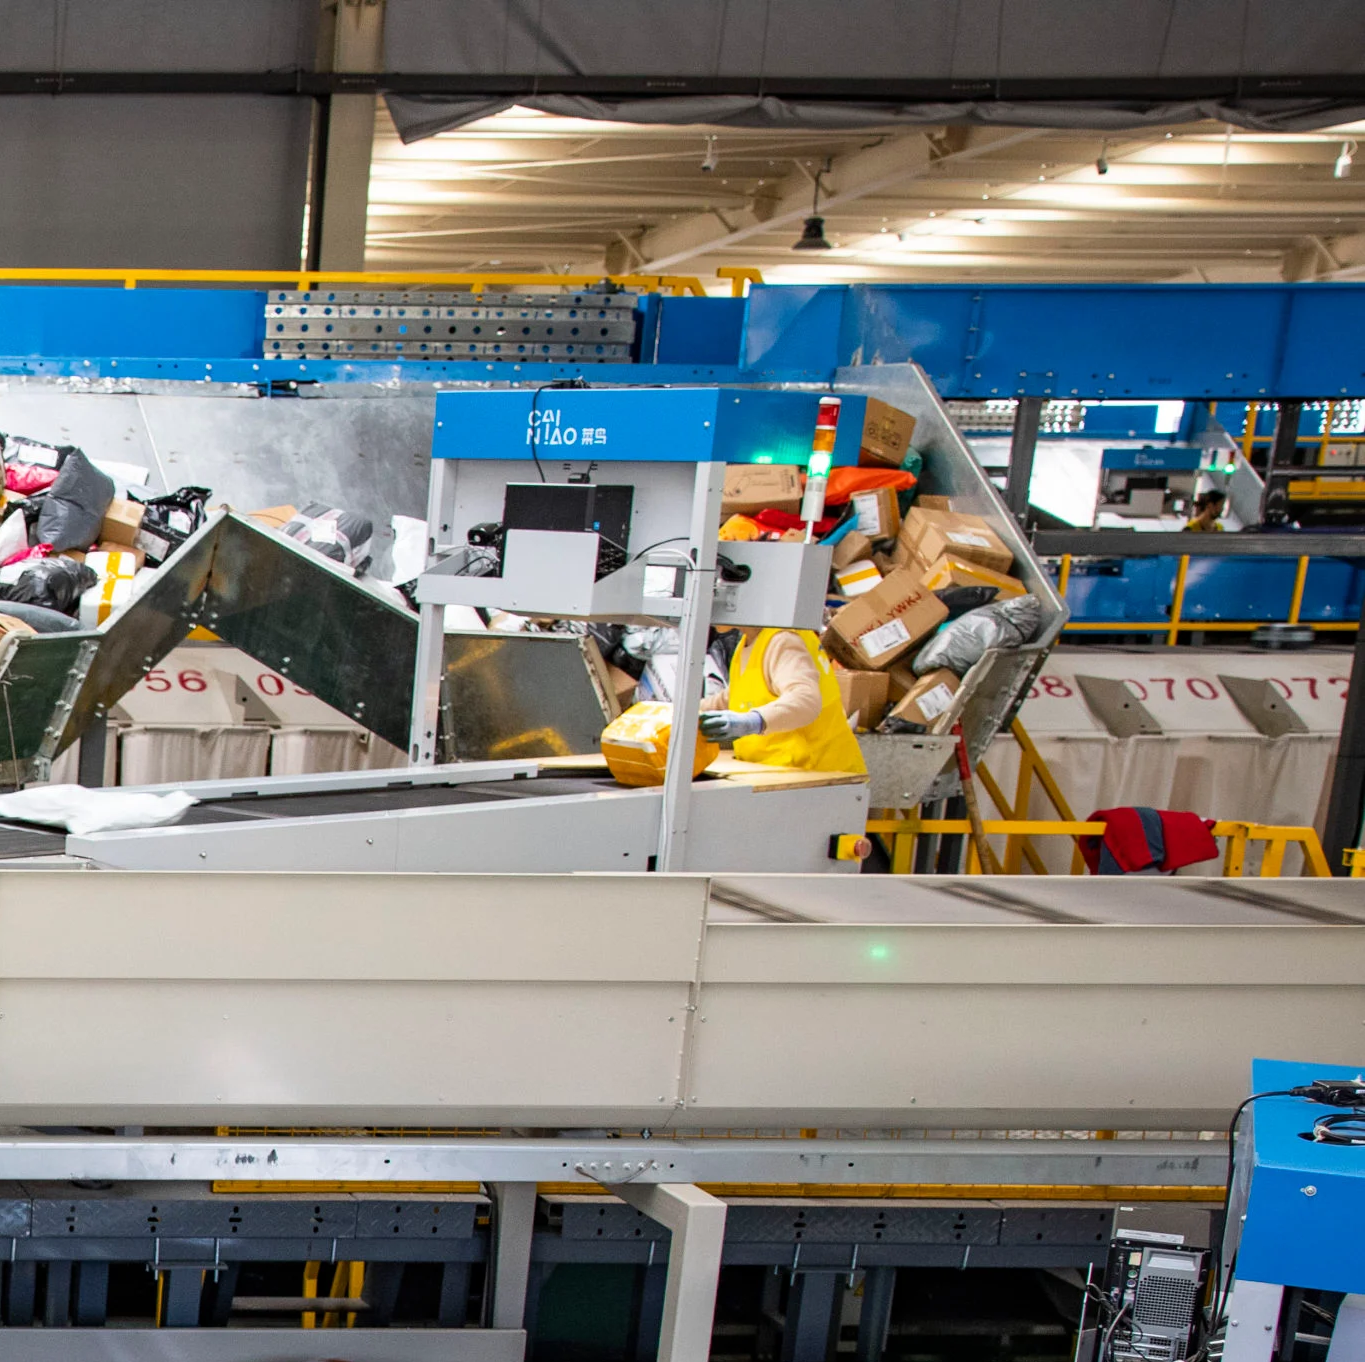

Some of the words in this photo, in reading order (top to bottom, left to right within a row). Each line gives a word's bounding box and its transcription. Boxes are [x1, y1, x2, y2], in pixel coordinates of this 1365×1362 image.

[528, 409, 561, 427] CAI
[581, 427, 607, 446] 菜鸟
[886, 591, 923, 618] YWKJ
